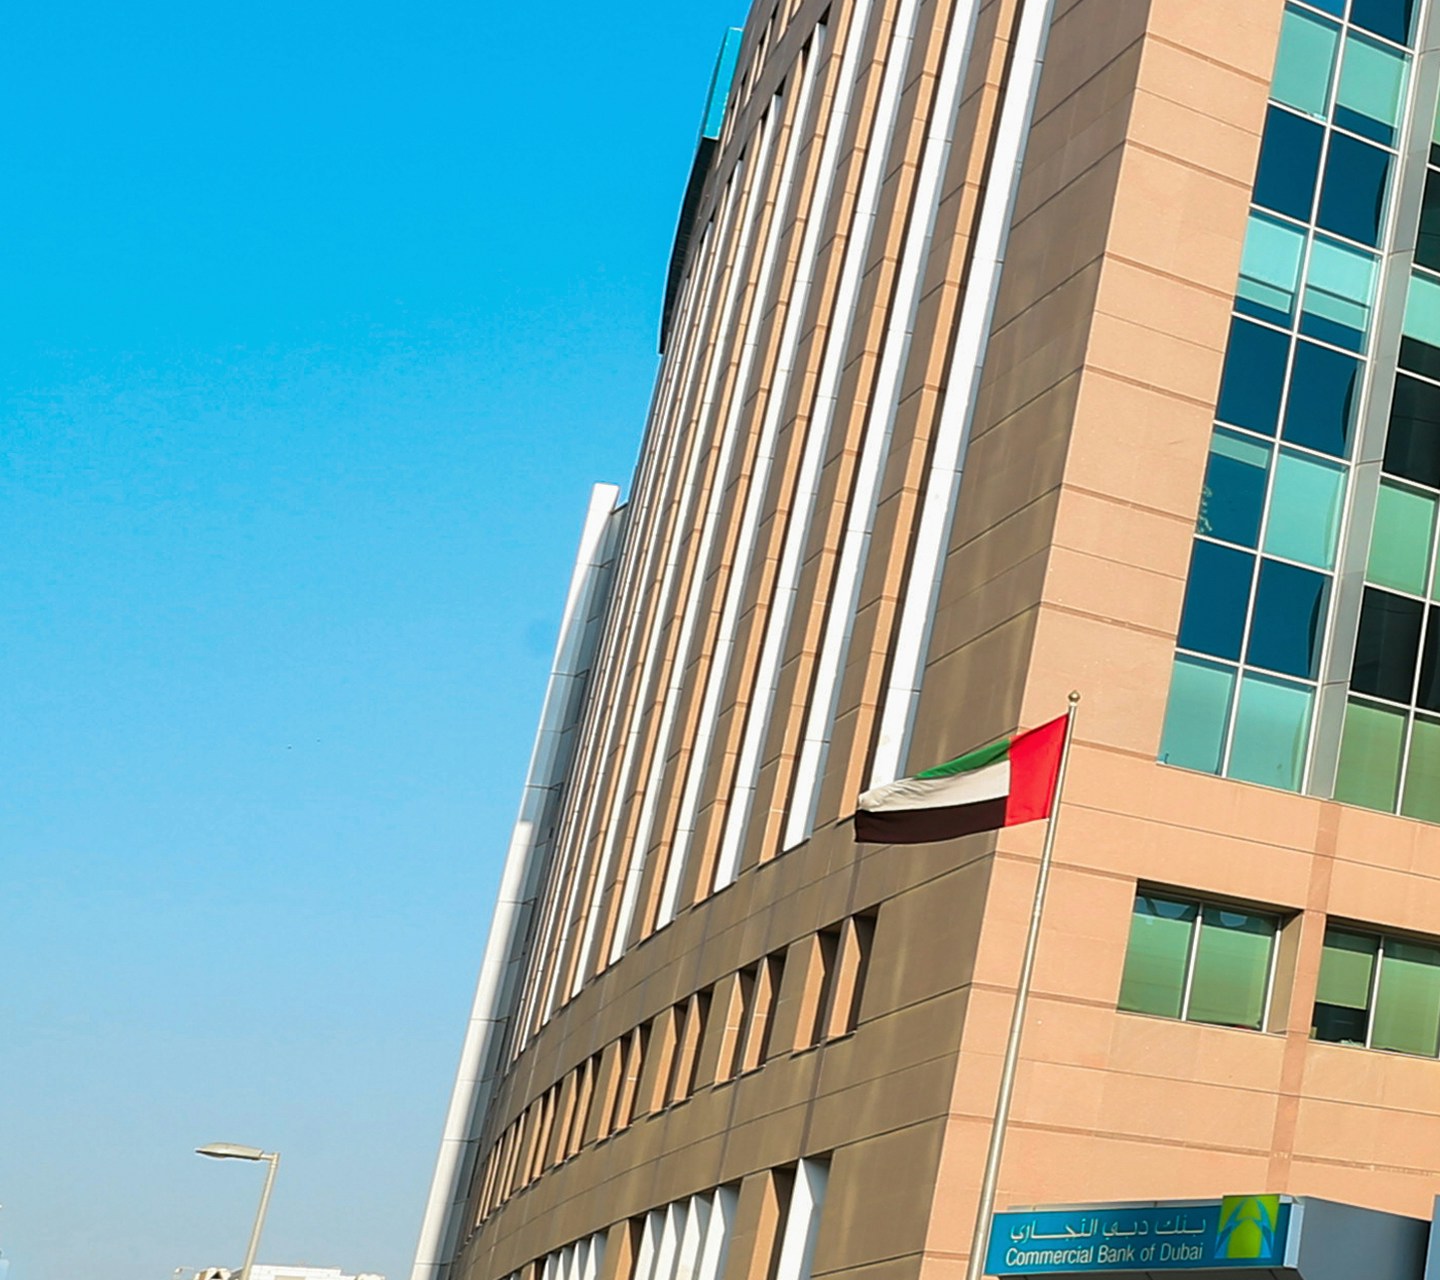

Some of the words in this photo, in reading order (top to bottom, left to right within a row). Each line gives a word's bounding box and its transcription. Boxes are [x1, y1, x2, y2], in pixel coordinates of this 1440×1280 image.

[1010, 1218, 1098, 1243] التجاري
[1102, 1220, 1149, 1241] دبي
[1155, 1214, 1207, 1236] بنك
[1006, 1244, 1094, 1267] Commercial
[1097, 1245, 1135, 1264] Bank
[1140, 1244, 1156, 1262] of
[1160, 1242, 1203, 1261] Dubai
